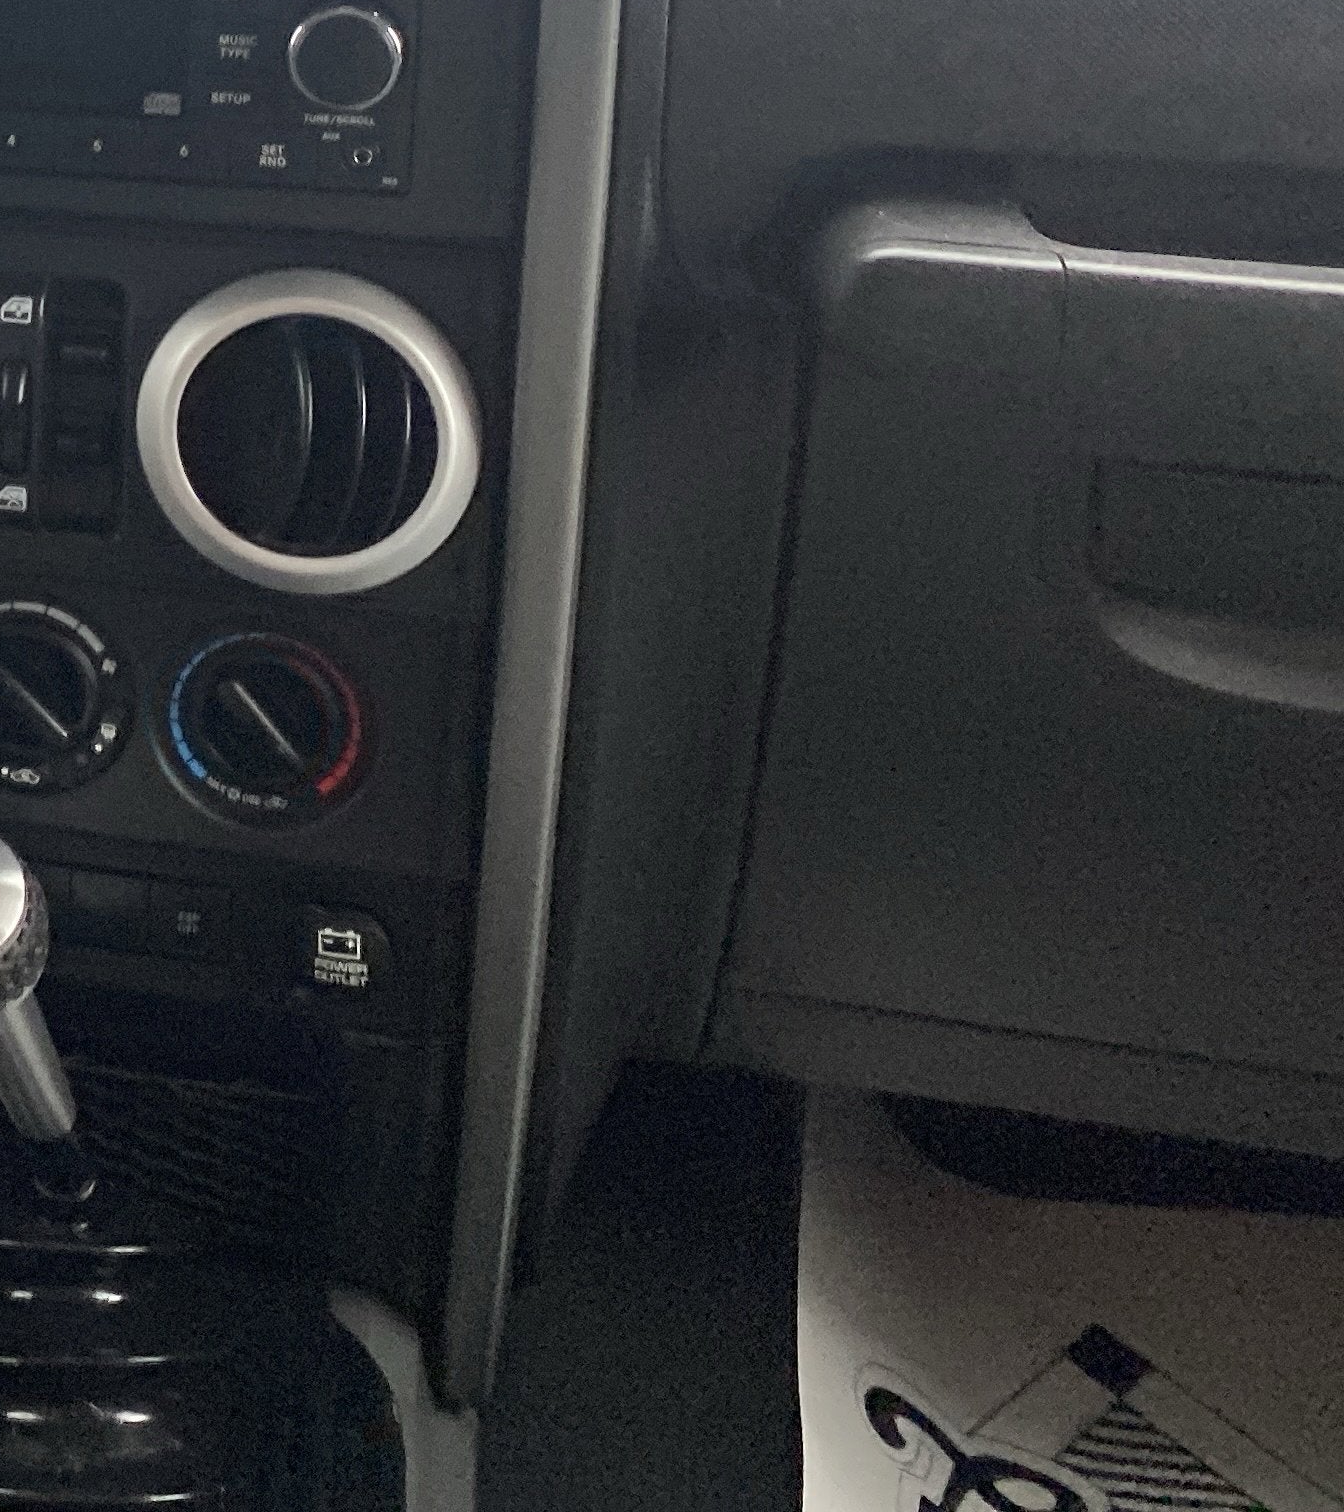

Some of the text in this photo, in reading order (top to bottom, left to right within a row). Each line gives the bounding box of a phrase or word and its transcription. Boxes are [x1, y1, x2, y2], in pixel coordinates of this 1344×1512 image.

[219, 33, 258, 47] MUSIC
[220, 46, 251, 60] TYPE
[211, 90, 251, 105] SETUP
[303, 112, 376, 127] TUNE/SCROLL
[6, 133, 17, 149] 4
[93, 138, 103, 154] 5
[179, 143, 190, 158] 6
[261, 143, 286, 156] SET
[259, 155, 287, 168] RND
[314, 957, 369, 975] POWER
[314, 970, 369, 988] OUTLET
